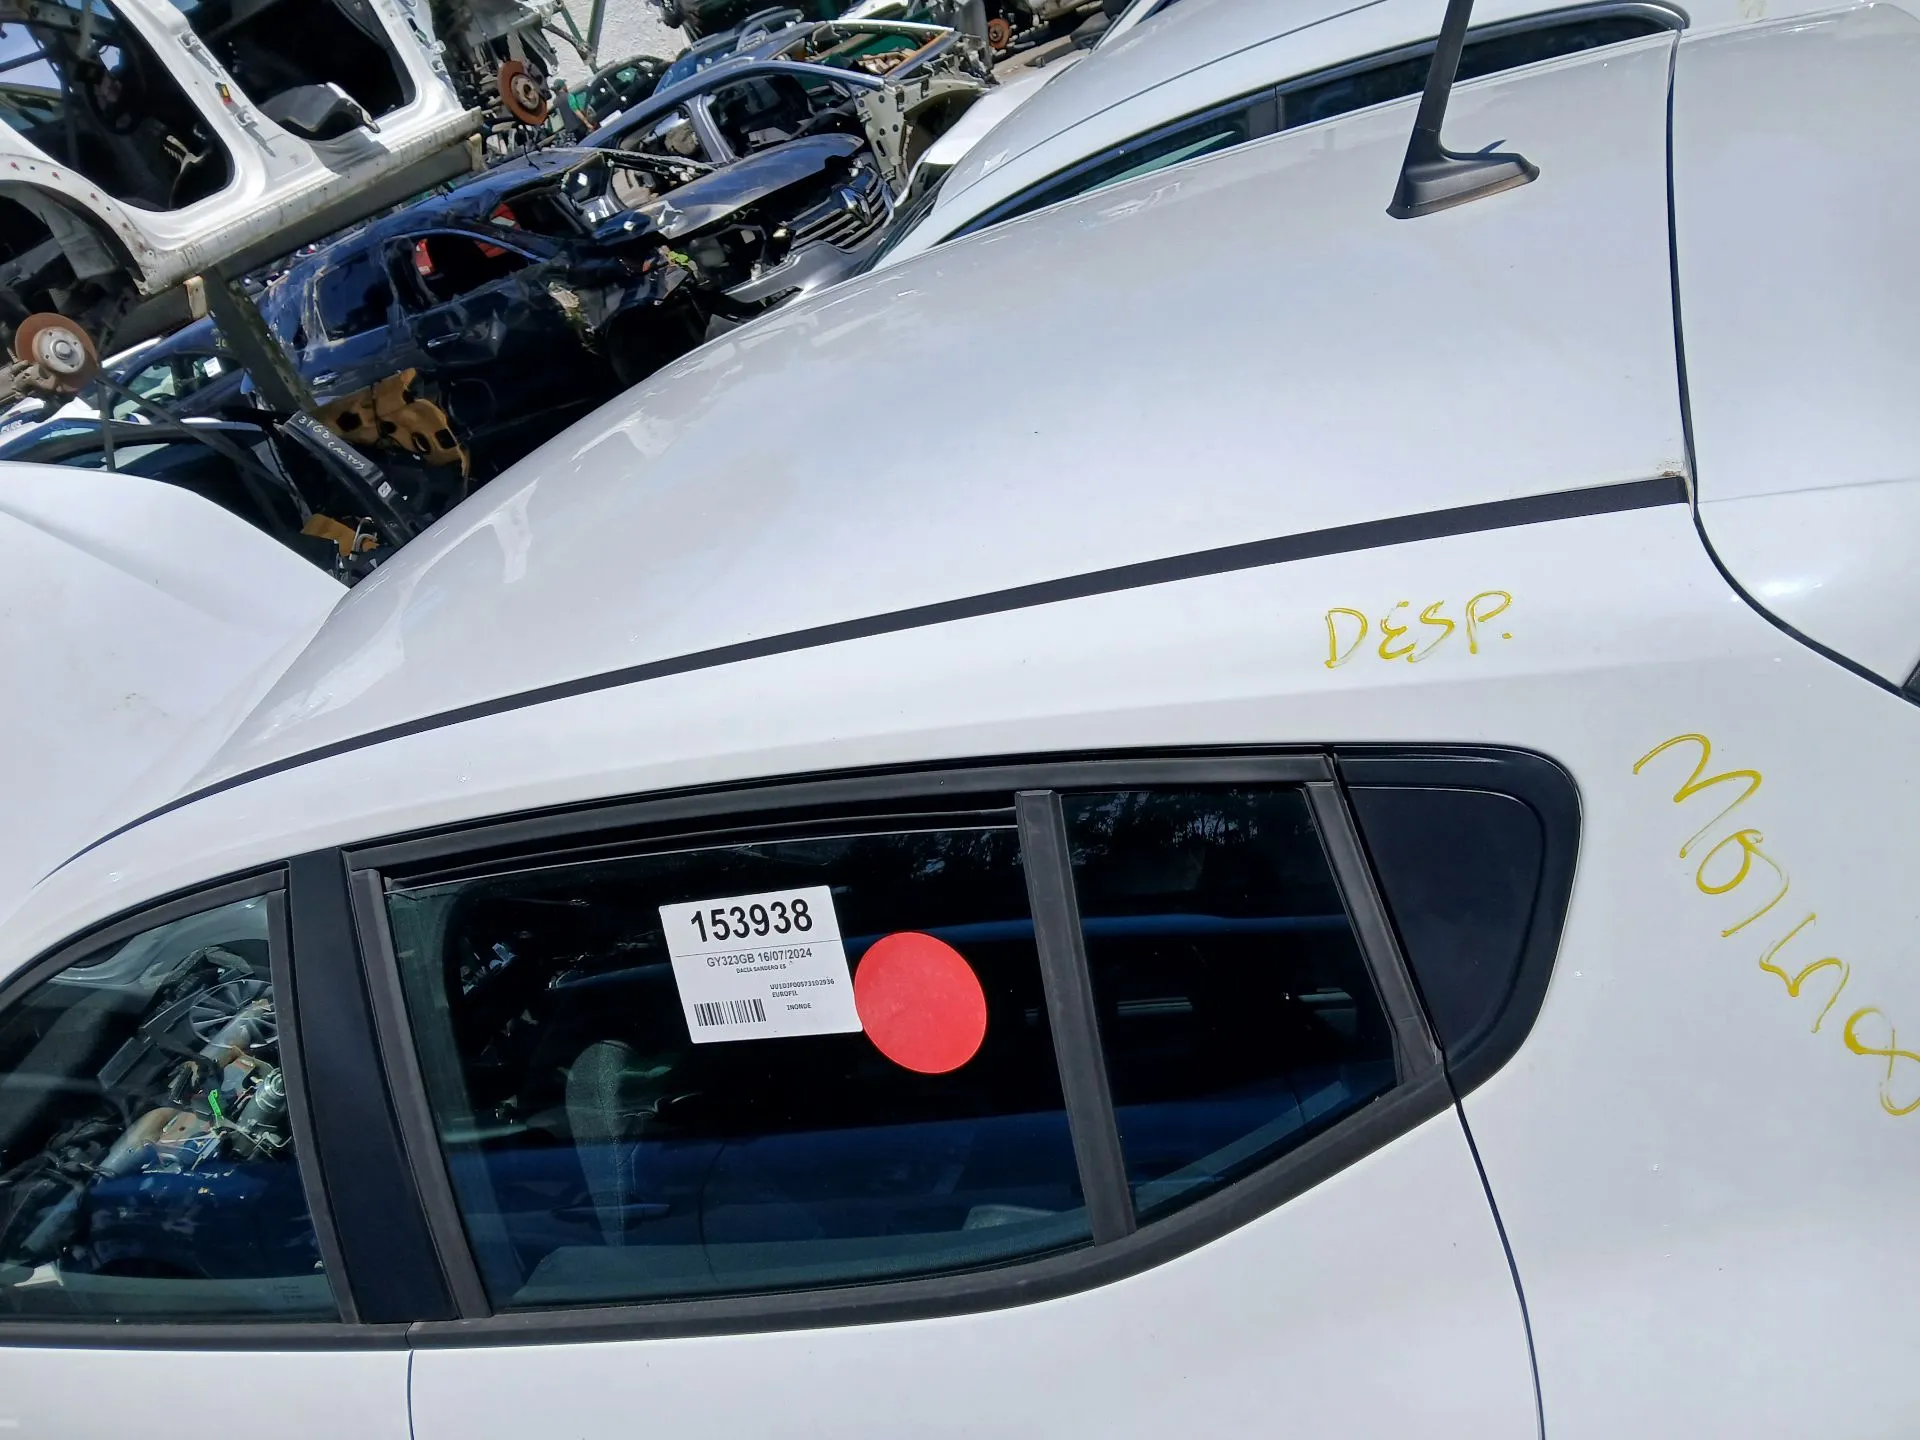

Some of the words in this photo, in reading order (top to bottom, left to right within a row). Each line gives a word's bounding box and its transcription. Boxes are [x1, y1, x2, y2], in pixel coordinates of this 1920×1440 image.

[690, 898, 813, 942] 153938
[706, 953, 755, 967] GY323GB
[758, 948, 813, 962] 16/07/2024
[736, 966, 753, 974] DACIA
[753, 964, 779, 972] SANDERO
[771, 990, 799, 998] EUROFIL
[786, 1002, 812, 1011] INONDE
